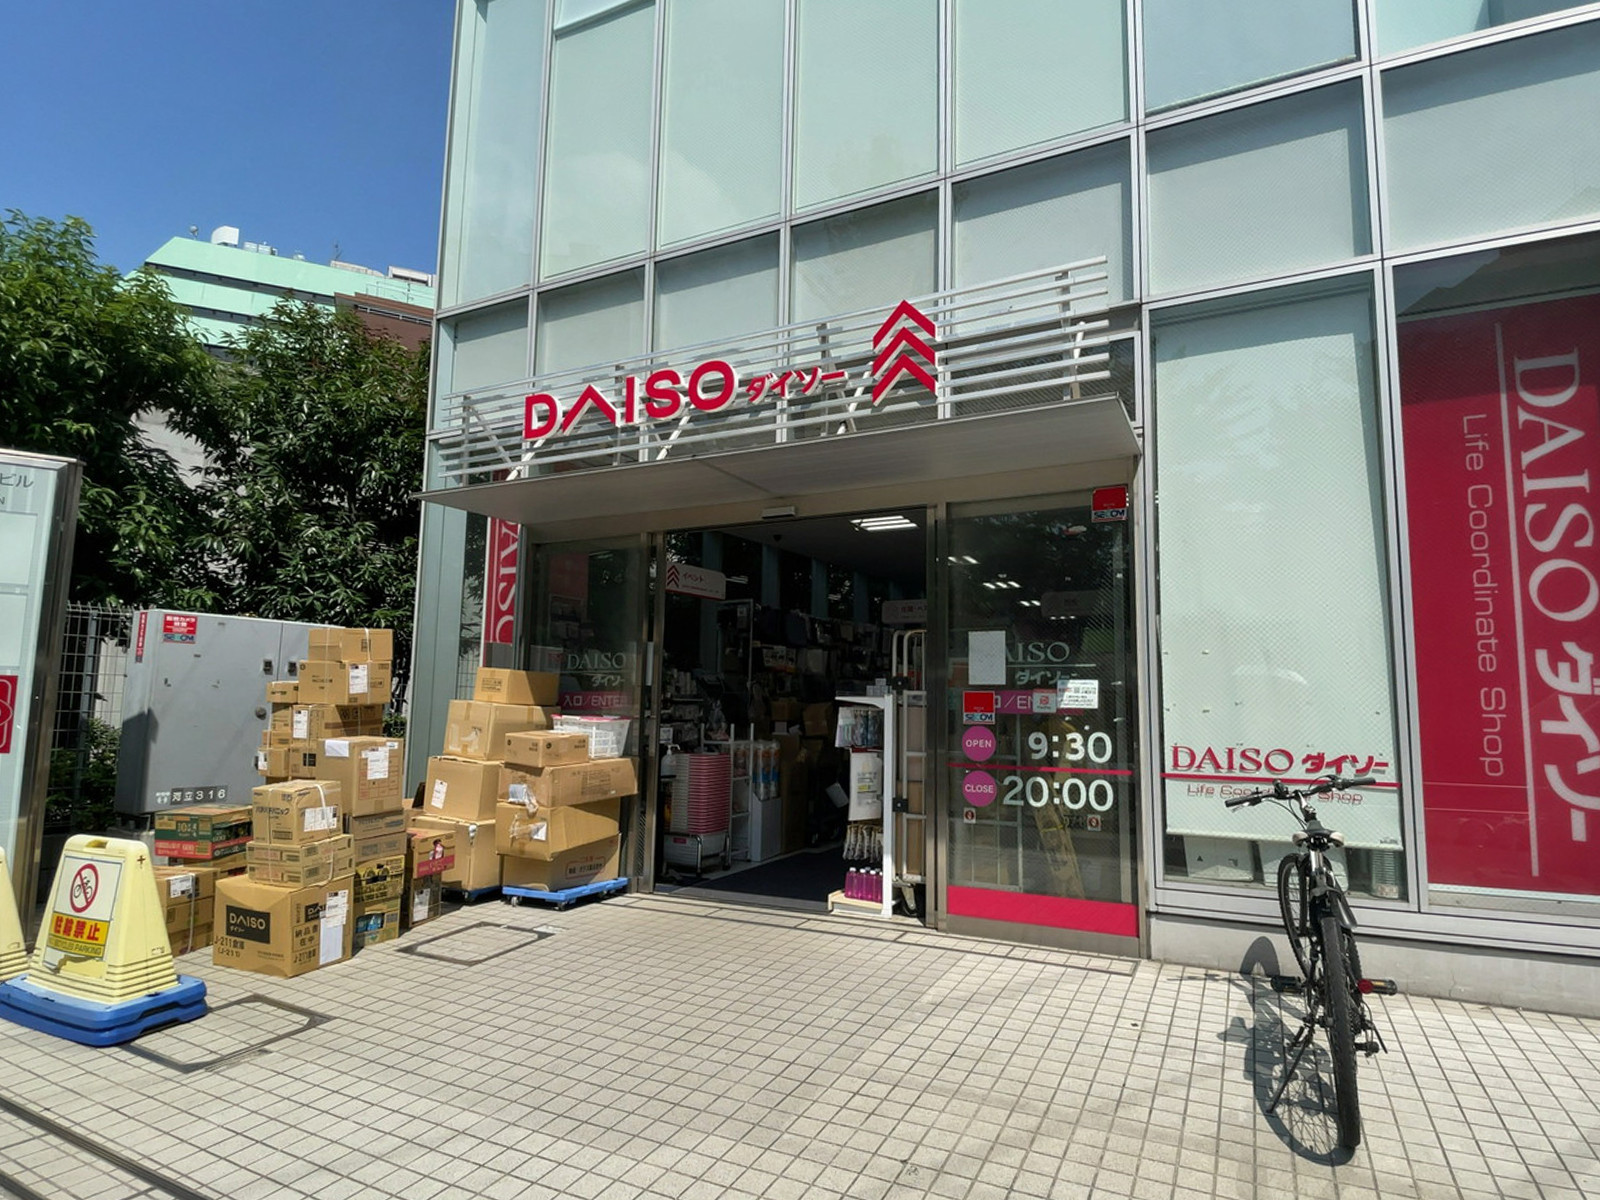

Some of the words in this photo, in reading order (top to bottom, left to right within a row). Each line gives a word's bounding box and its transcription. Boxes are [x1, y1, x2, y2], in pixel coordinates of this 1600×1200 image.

[524, 360, 735, 439] DAISO
[746, 367, 847, 402] ダイソー
[1463, 414, 1489, 471] Life
[1514, 347, 1600, 621] DAISO
[1468, 484, 1499, 672] Coordinate
[567, 652, 627, 670] DAISO
[965, 740, 992, 748] OPEN
[1028, 732, 1113, 763] 9:30
[1480, 687, 1506, 777] Shop
[1171, 746, 1293, 773] DAISO
[1302, 752, 1388, 774] ダイソー
[965, 784, 993, 793] CLOSE
[1002, 776, 1114, 811] 20:00
[230, 912, 266, 930] DAISO
